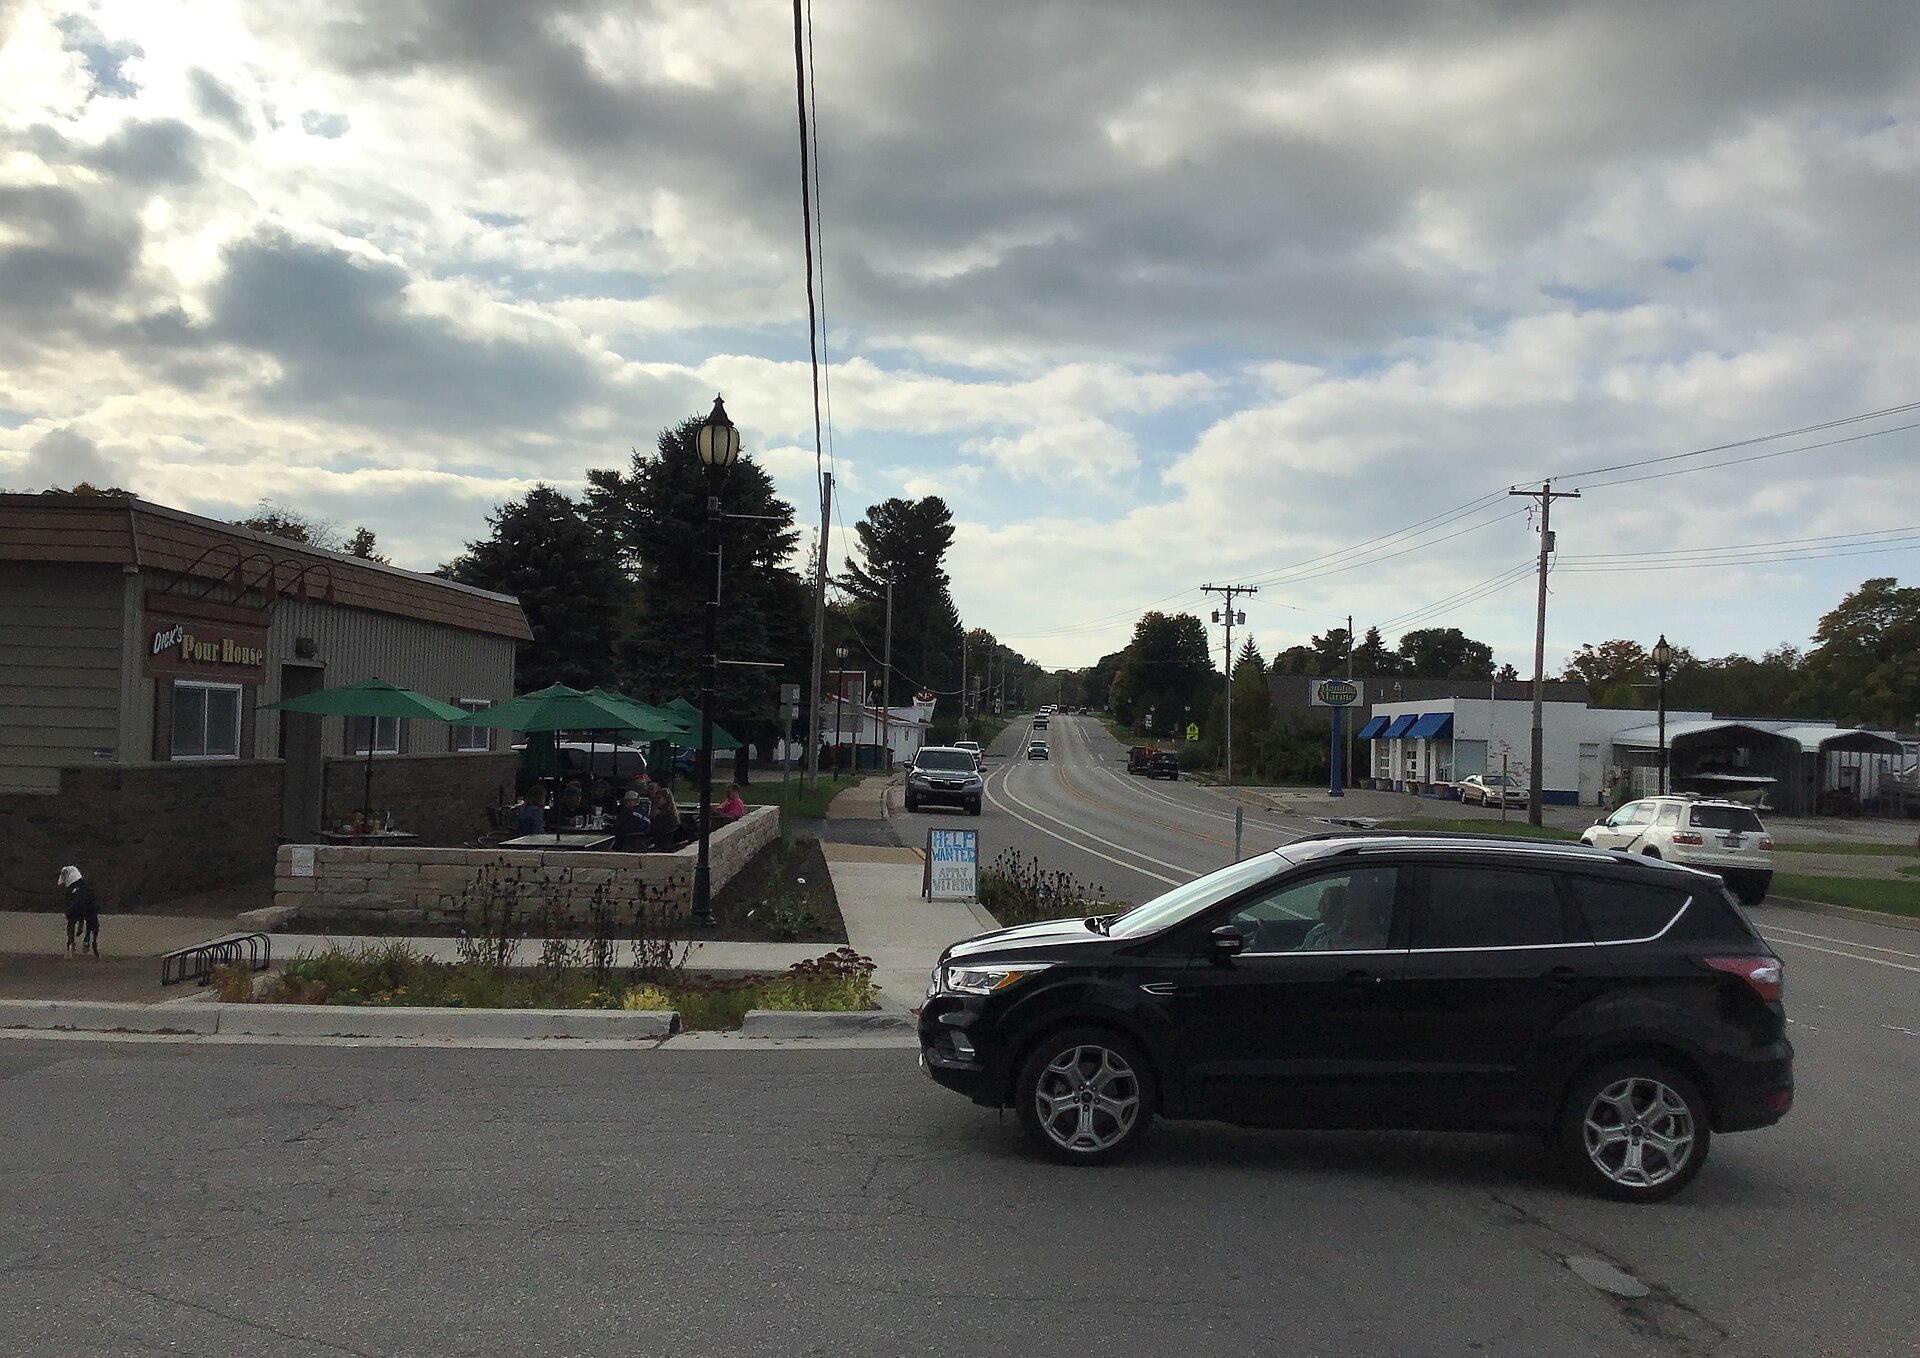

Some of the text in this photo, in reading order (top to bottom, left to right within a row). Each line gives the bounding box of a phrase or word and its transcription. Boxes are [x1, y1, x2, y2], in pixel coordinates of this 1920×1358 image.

[181, 634, 263, 666] Pour House
[933, 831, 974, 848] HELP
[932, 848, 976, 863] WANTED
[938, 867, 968, 878] APPLY
[932, 878, 974, 892] WITHIN
